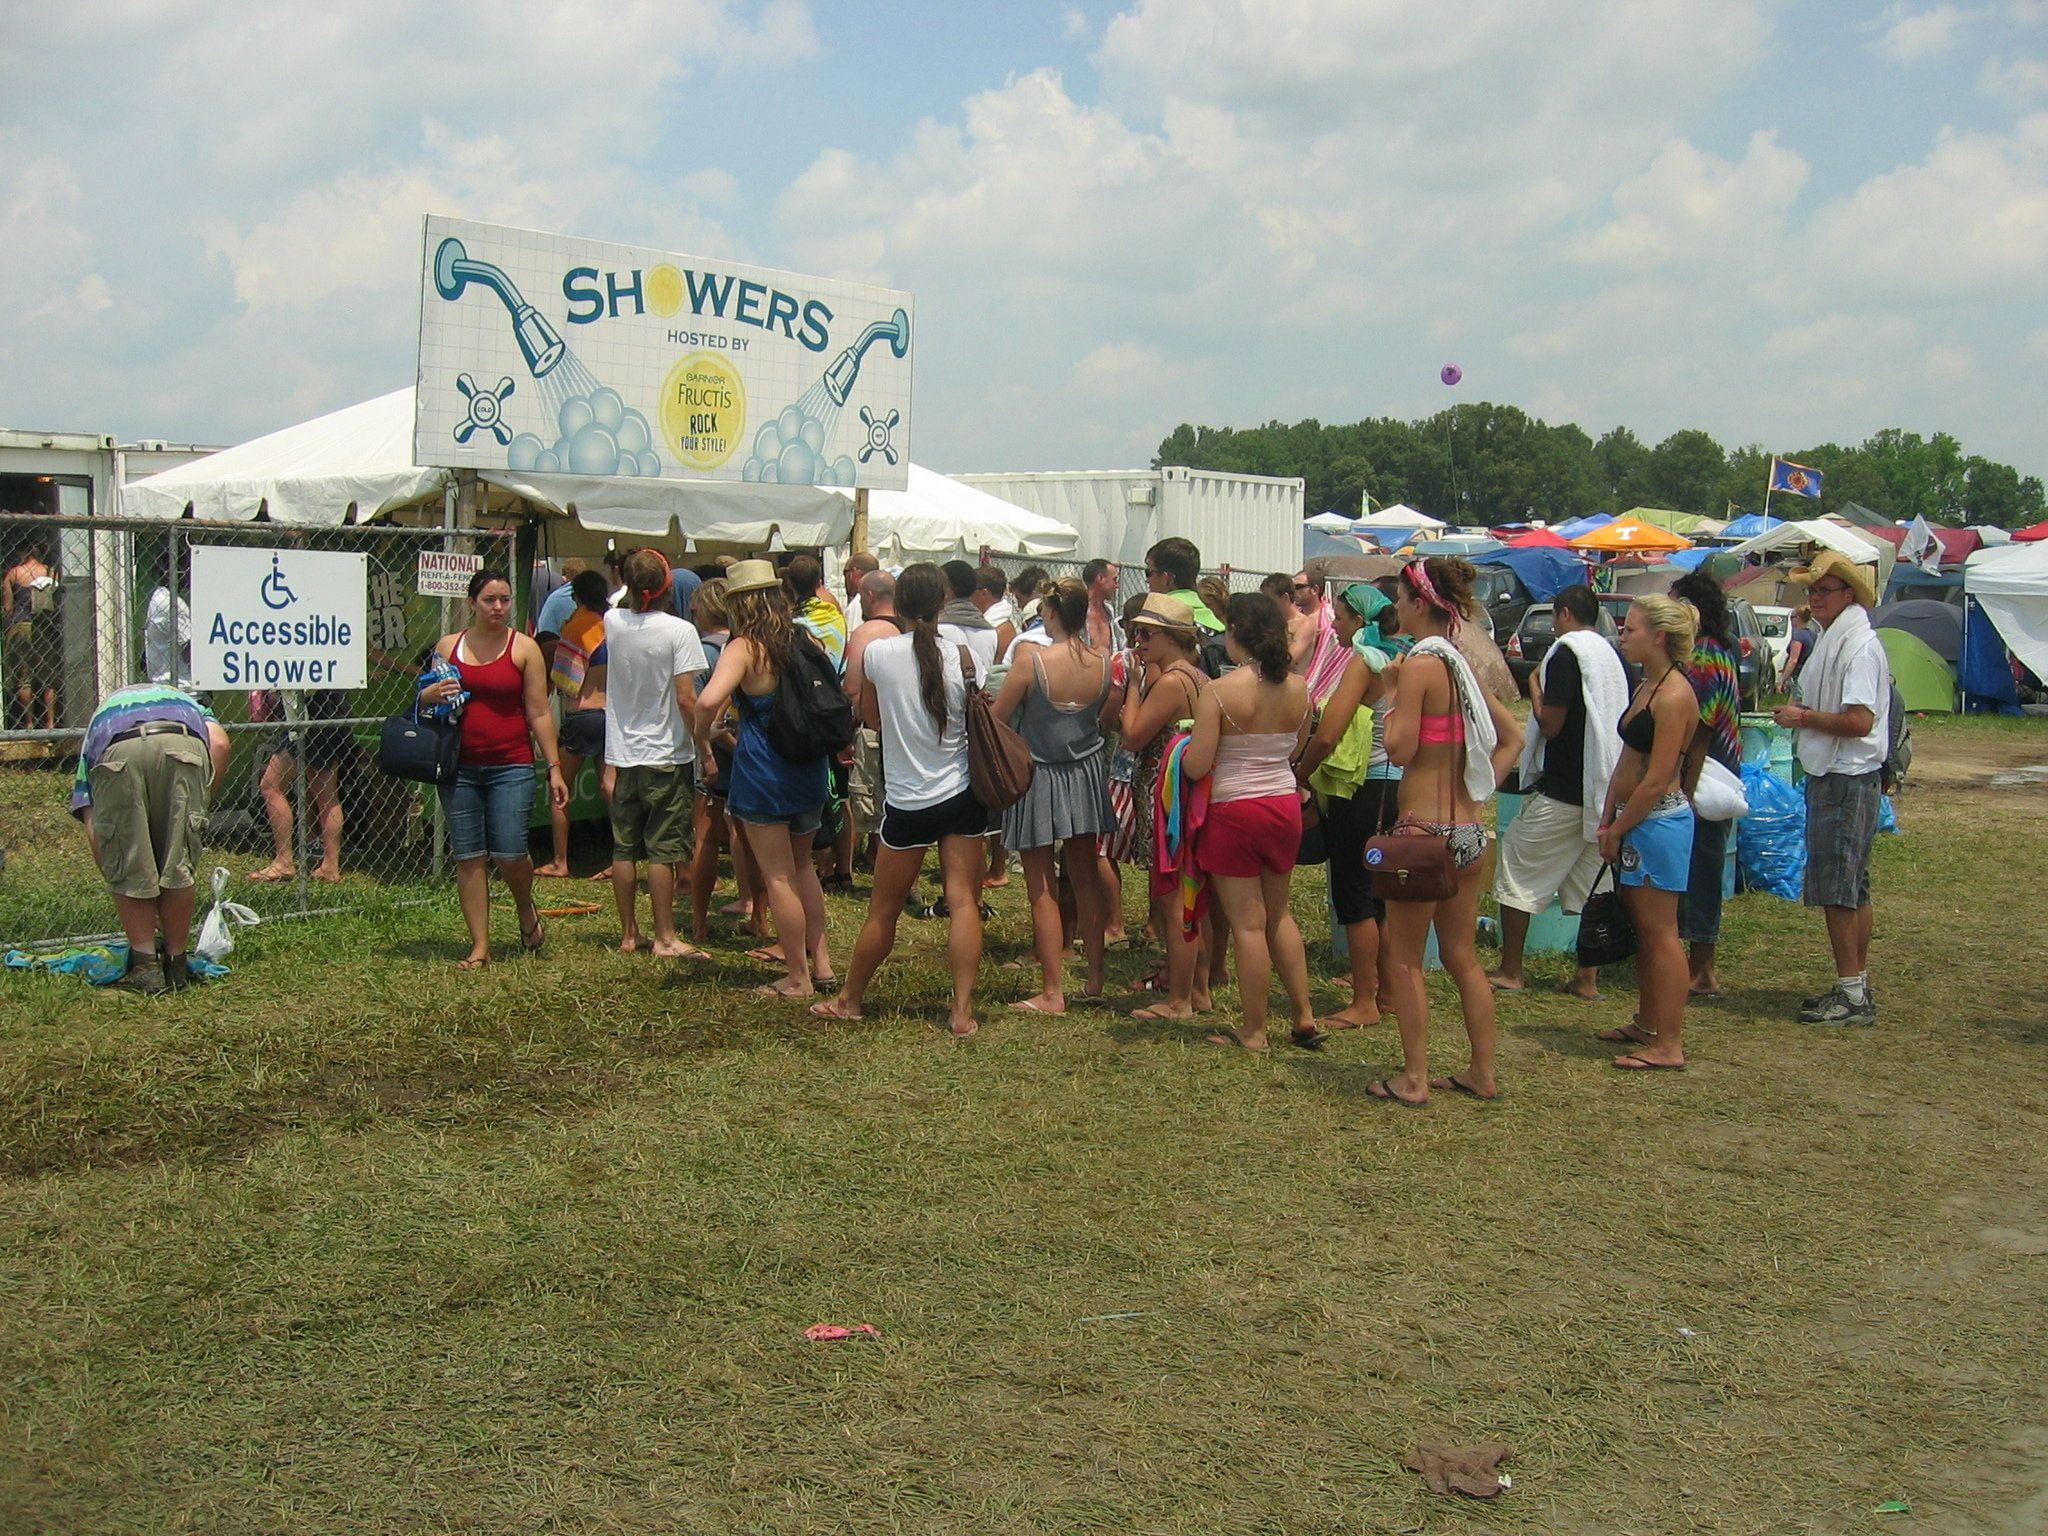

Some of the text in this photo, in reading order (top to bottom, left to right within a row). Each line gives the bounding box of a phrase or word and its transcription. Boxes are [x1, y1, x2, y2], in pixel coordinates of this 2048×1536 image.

[562, 266, 834, 352] SHOWERS
[667, 329, 750, 351] HOSTED BY
[690, 412, 718, 435] ROCK
[681, 436, 727, 453] YOUR STYLE!
[1615, 526, 1638, 541] T
[421, 553, 481, 573] NATIONAL
[421, 571, 472, 582] RENT-A-FEN
[368, 571, 406, 609] HE
[209, 612, 352, 646] Accessible
[222, 651, 338, 684] Shower
